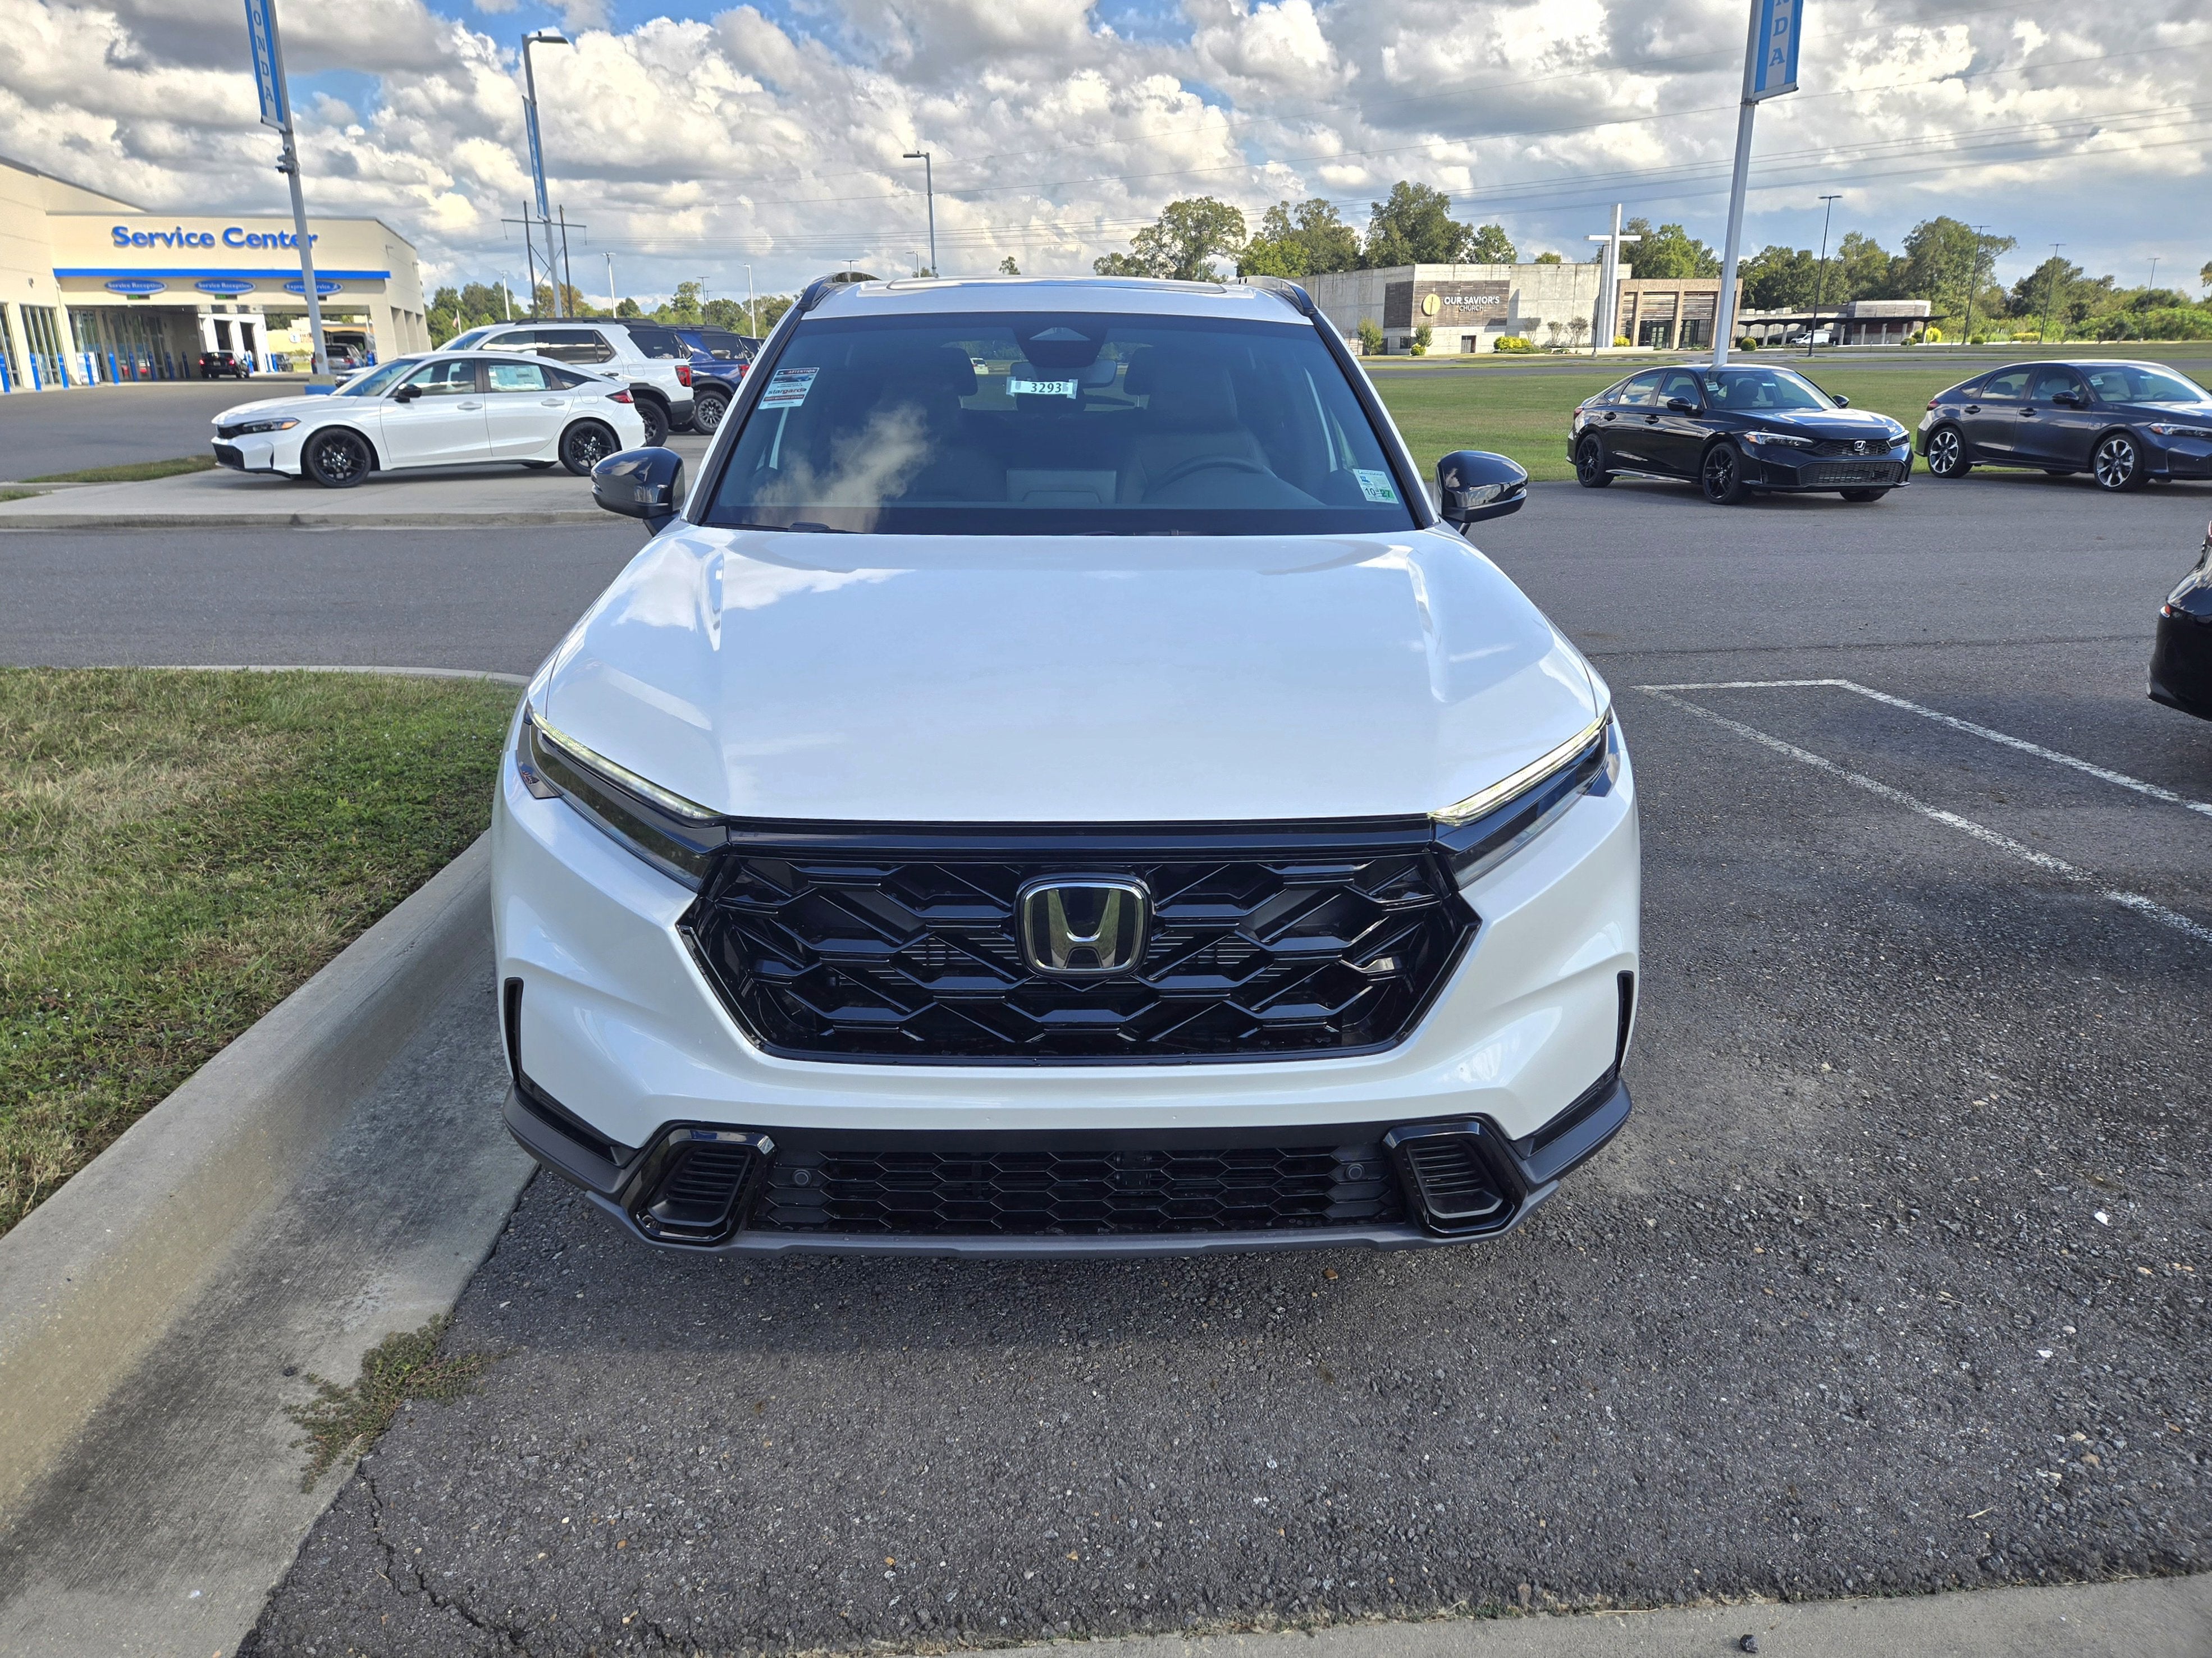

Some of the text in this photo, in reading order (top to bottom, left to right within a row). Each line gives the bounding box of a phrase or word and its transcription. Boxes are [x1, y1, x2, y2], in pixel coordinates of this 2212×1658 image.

[250, 0, 274, 103] ONDA
[111, 226, 318, 249] Service Center
[1444, 296, 1500, 305] OUR SAVIOR'S
[1030, 383, 1062, 393] 3293
